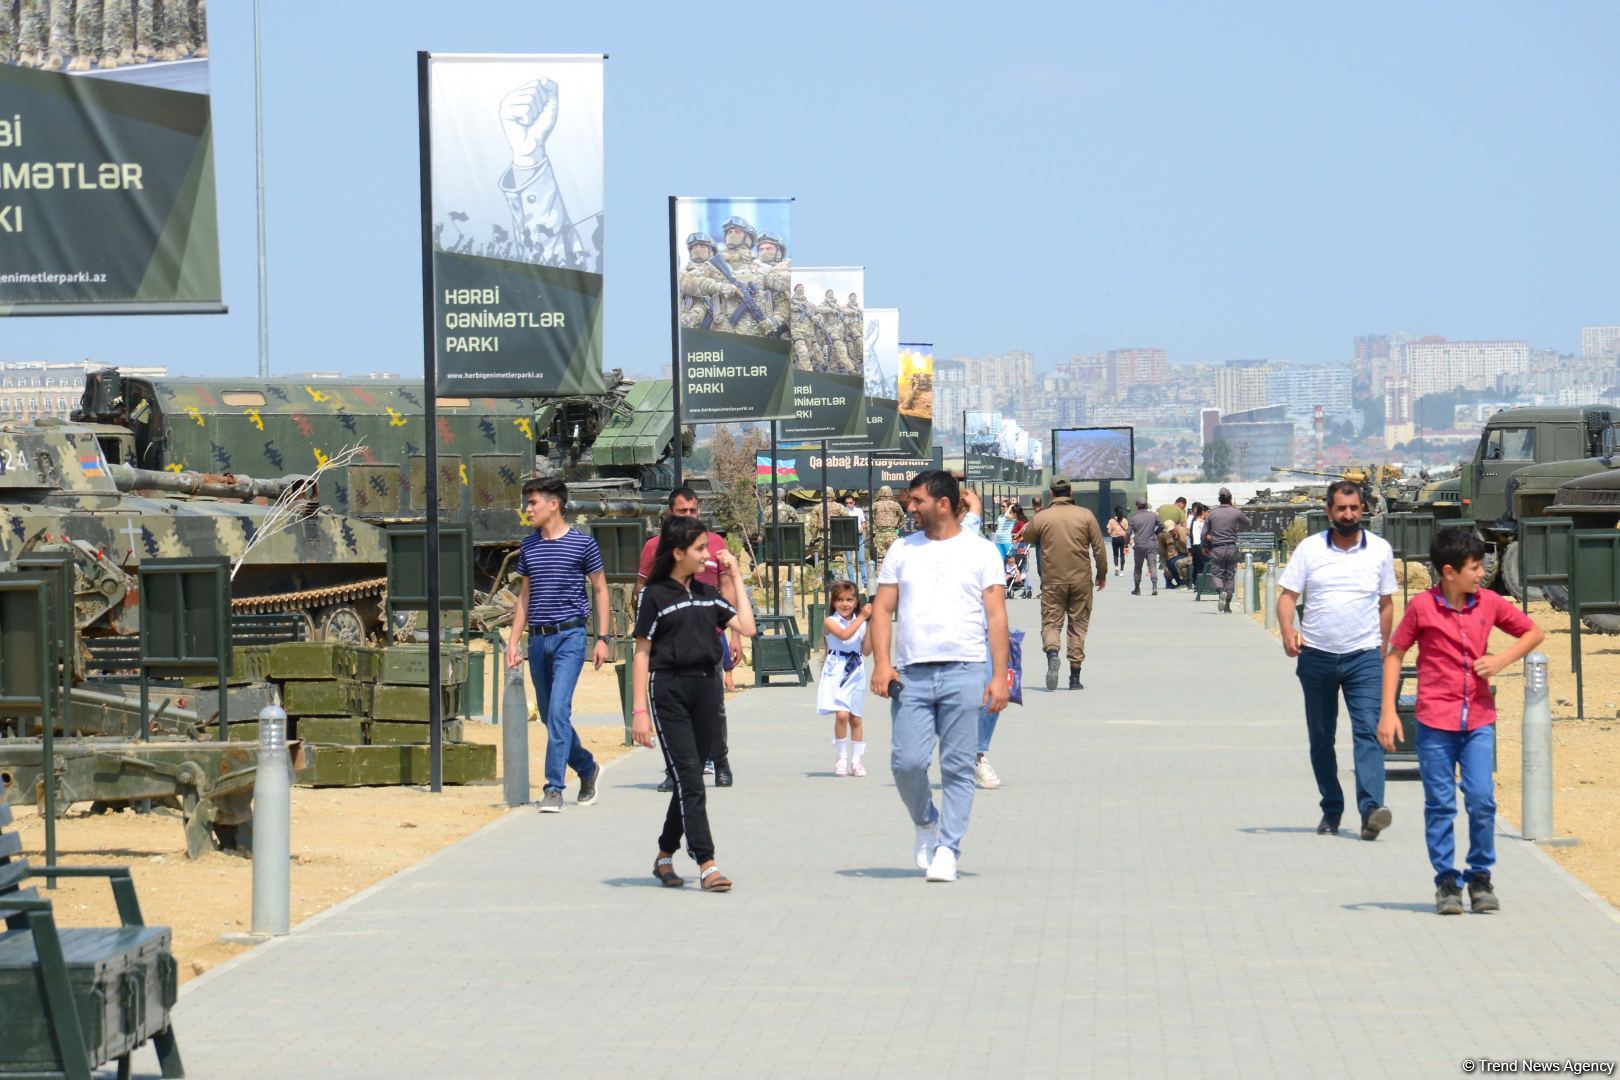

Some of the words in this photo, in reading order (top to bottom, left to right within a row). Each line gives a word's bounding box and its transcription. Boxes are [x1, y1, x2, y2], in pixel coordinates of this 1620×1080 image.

[0, 162, 143, 190] MƏTLƏR
[0, 272, 107, 287] enimetlerparki.az
[445, 285, 500, 305] HƏRBİ
[445, 309, 565, 330] QƏNİMƏTLƏR
[446, 336, 499, 352] PARKI
[687, 349, 724, 363] HƏRBİ
[447, 371, 544, 380] www.herbiqenimetlerparki.az
[688, 364, 768, 379] QƏNİMƏTLƏR
[688, 382, 724, 394] PARKI
[794, 396, 846, 407] NİMƏTLƏR
[0, 449, 29, 472] 24
[809, 455, 852, 469] Qaabağ
[881, 469, 905, 481] İlham
[906, 470, 921, 481] Əli
